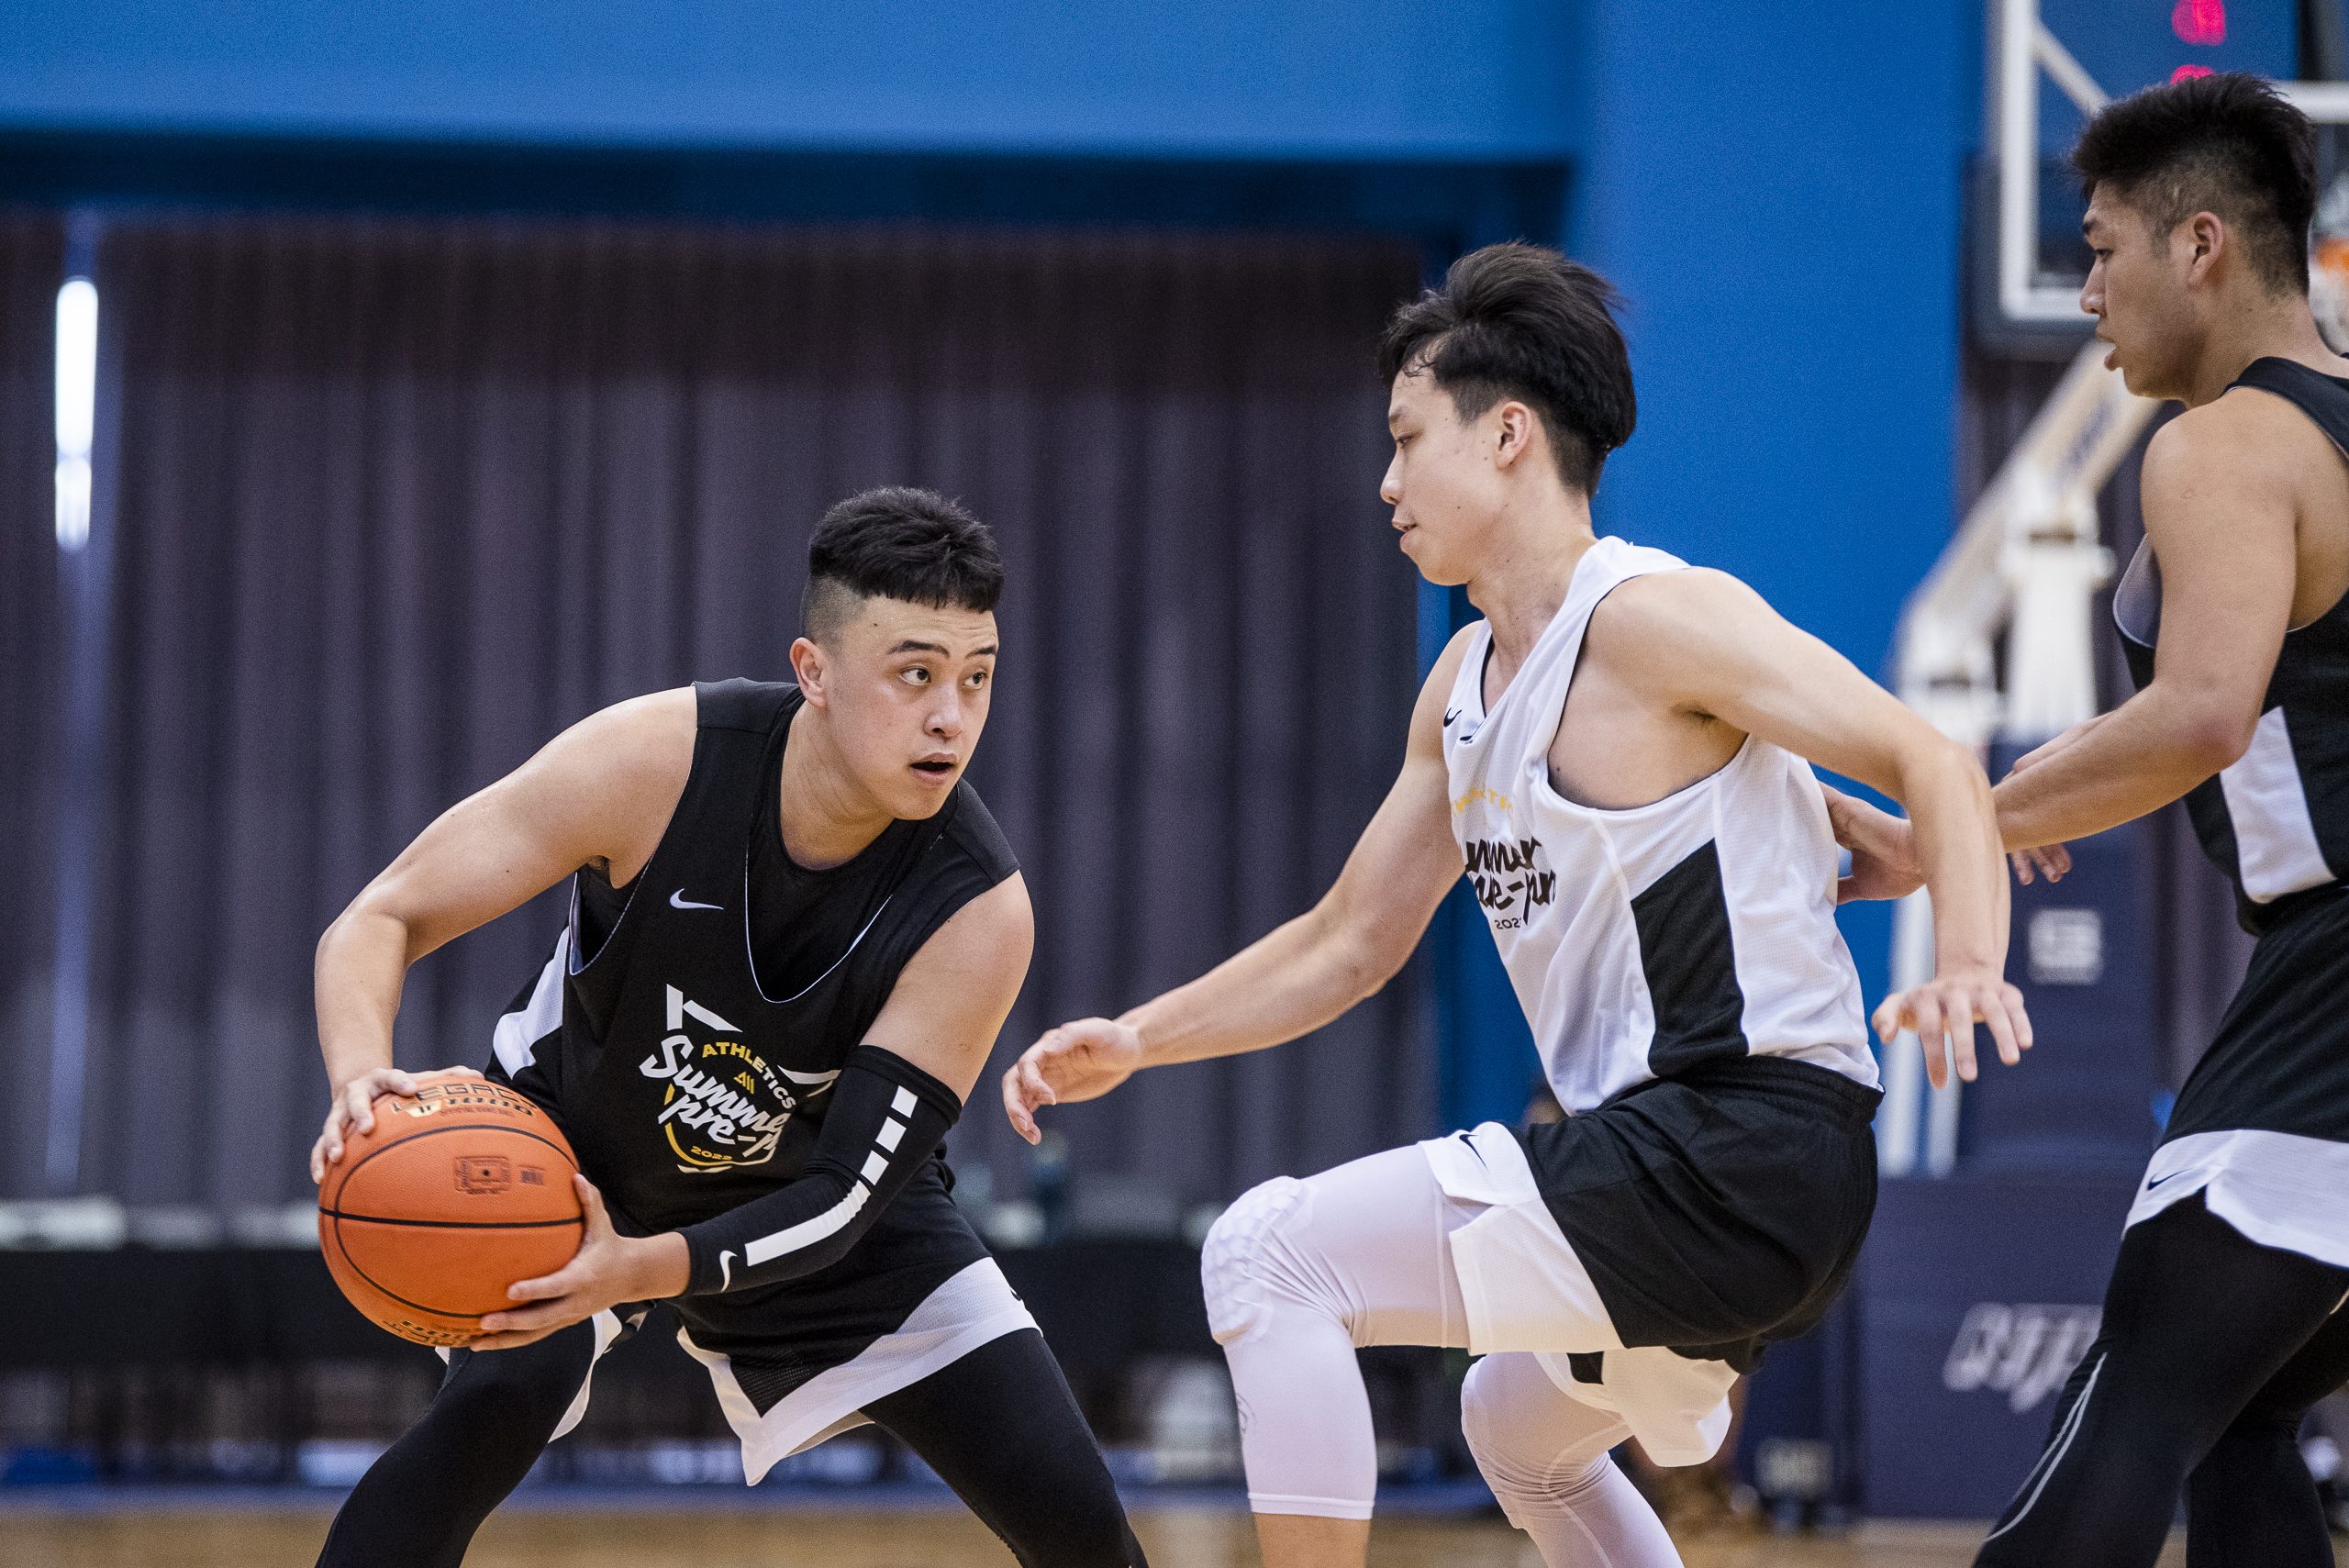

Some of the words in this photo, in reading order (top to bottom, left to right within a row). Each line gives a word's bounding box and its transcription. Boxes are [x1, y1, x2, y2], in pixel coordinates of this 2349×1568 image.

[1495, 917, 1522, 929] 202
[639, 1034, 792, 1133] Summe
[702, 1041, 796, 1109] ATHLETICS
[690, 1145, 733, 1162] 2022
